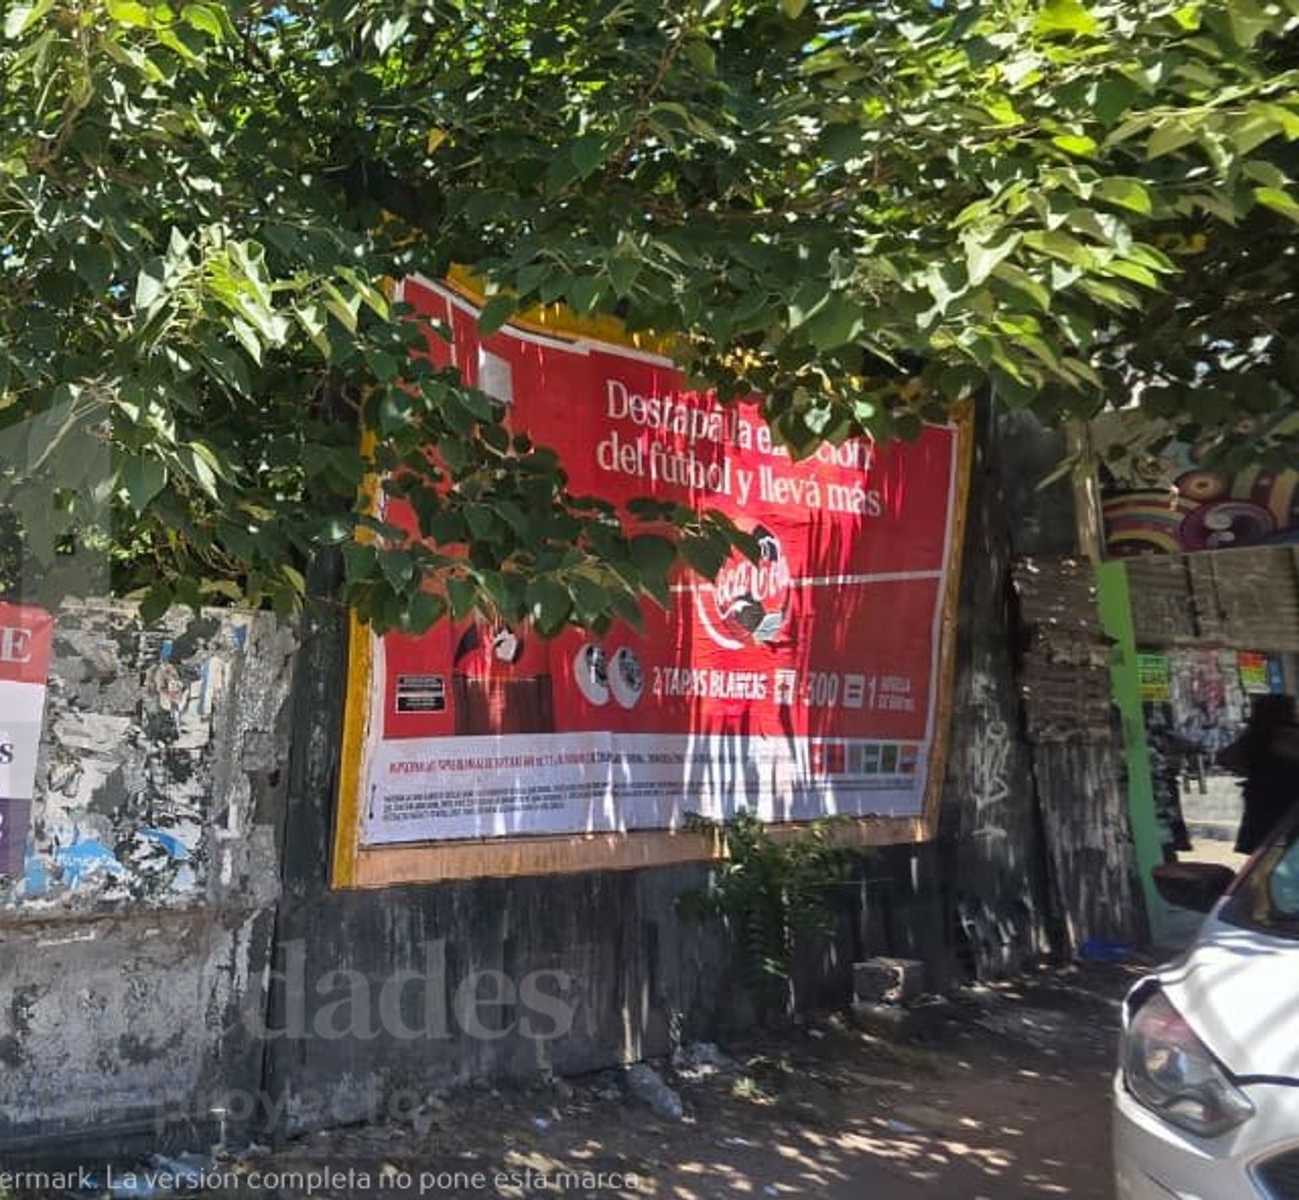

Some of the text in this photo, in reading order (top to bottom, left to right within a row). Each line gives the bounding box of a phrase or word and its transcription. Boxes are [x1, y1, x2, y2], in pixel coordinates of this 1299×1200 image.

[605, 379, 723, 444] Destapá
[731, 409, 751, 449] la
[597, 431, 883, 517] del fútbol y llevá más
[664, 667, 707, 697] TAPAS
